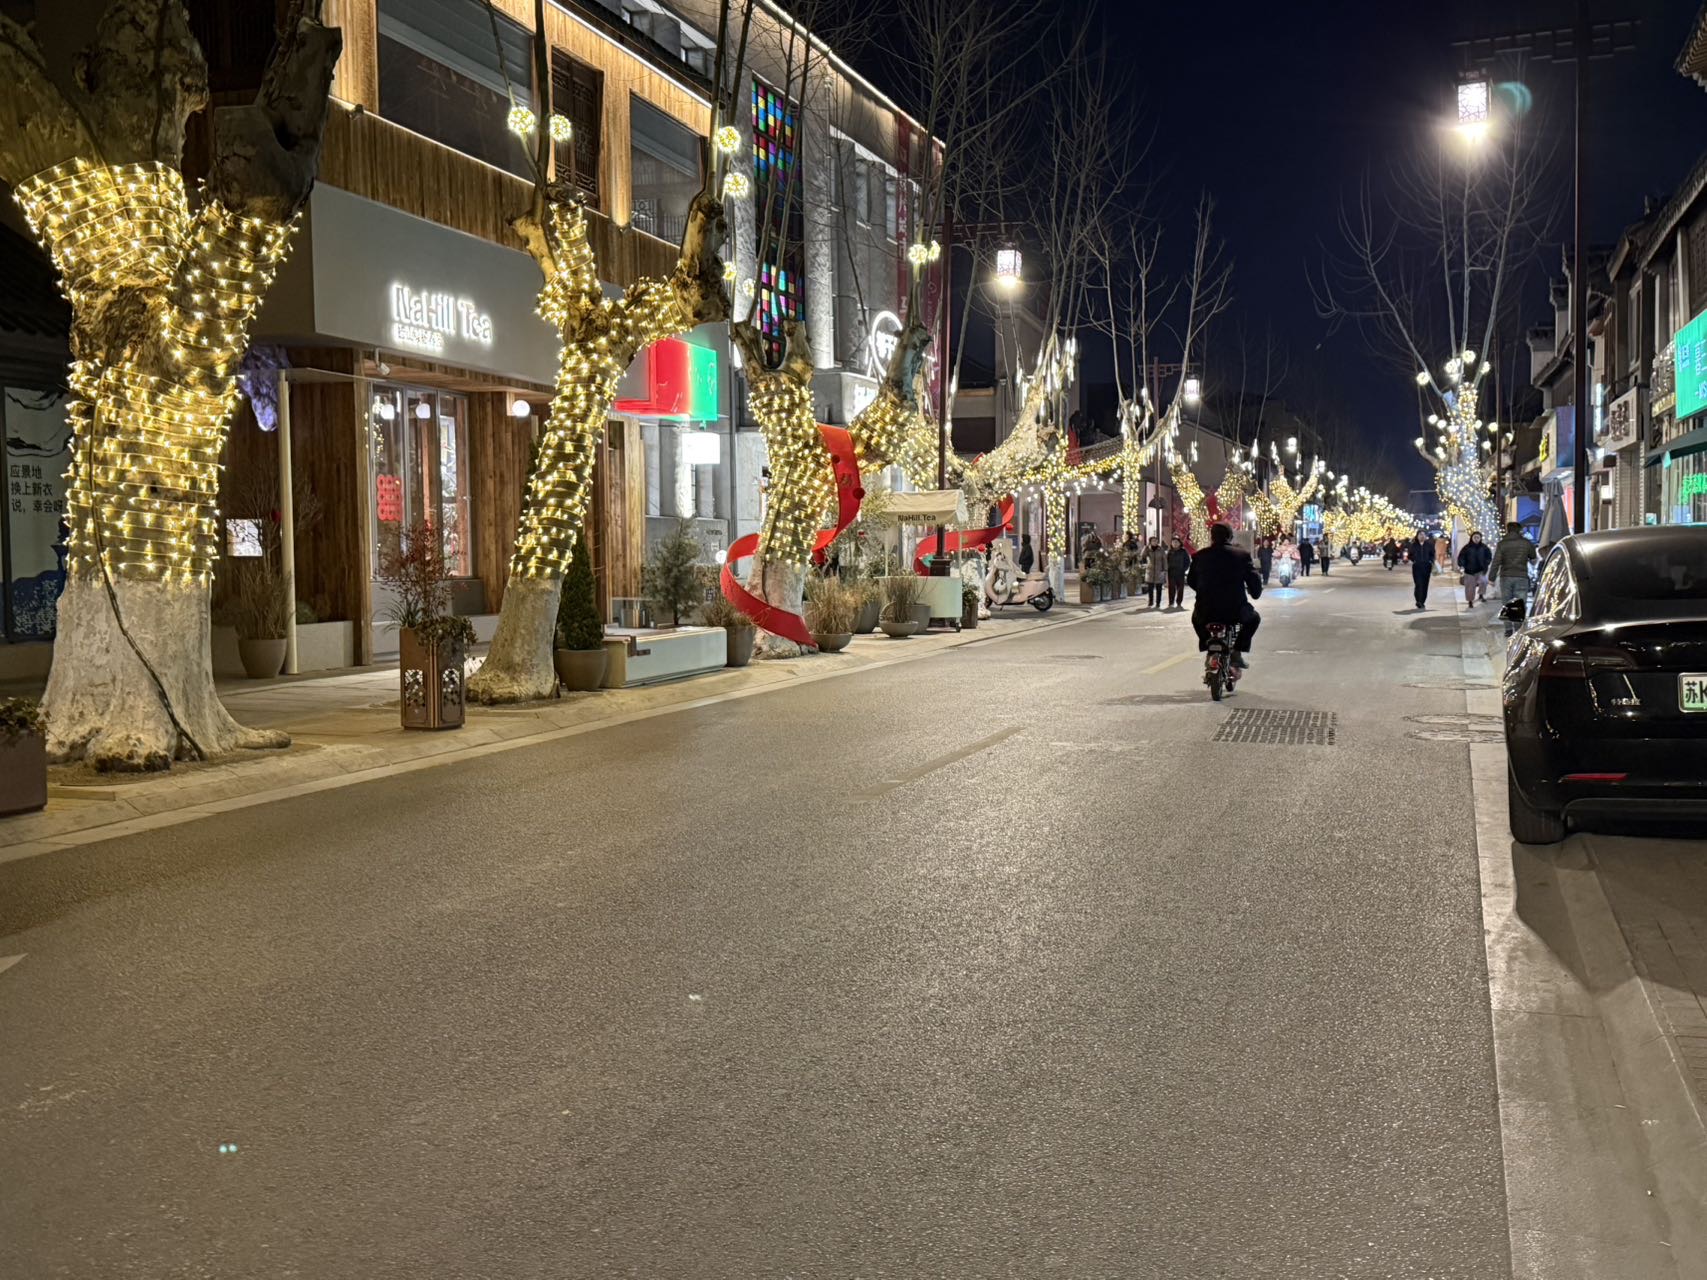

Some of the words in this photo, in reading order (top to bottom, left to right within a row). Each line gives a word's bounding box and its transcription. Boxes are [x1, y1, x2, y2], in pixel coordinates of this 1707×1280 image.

[390, 283, 457, 336] NaHill
[457, 298, 493, 345] Tea
[10, 464, 42, 479] 应景地
[11, 481, 53, 496] 换上新衣
